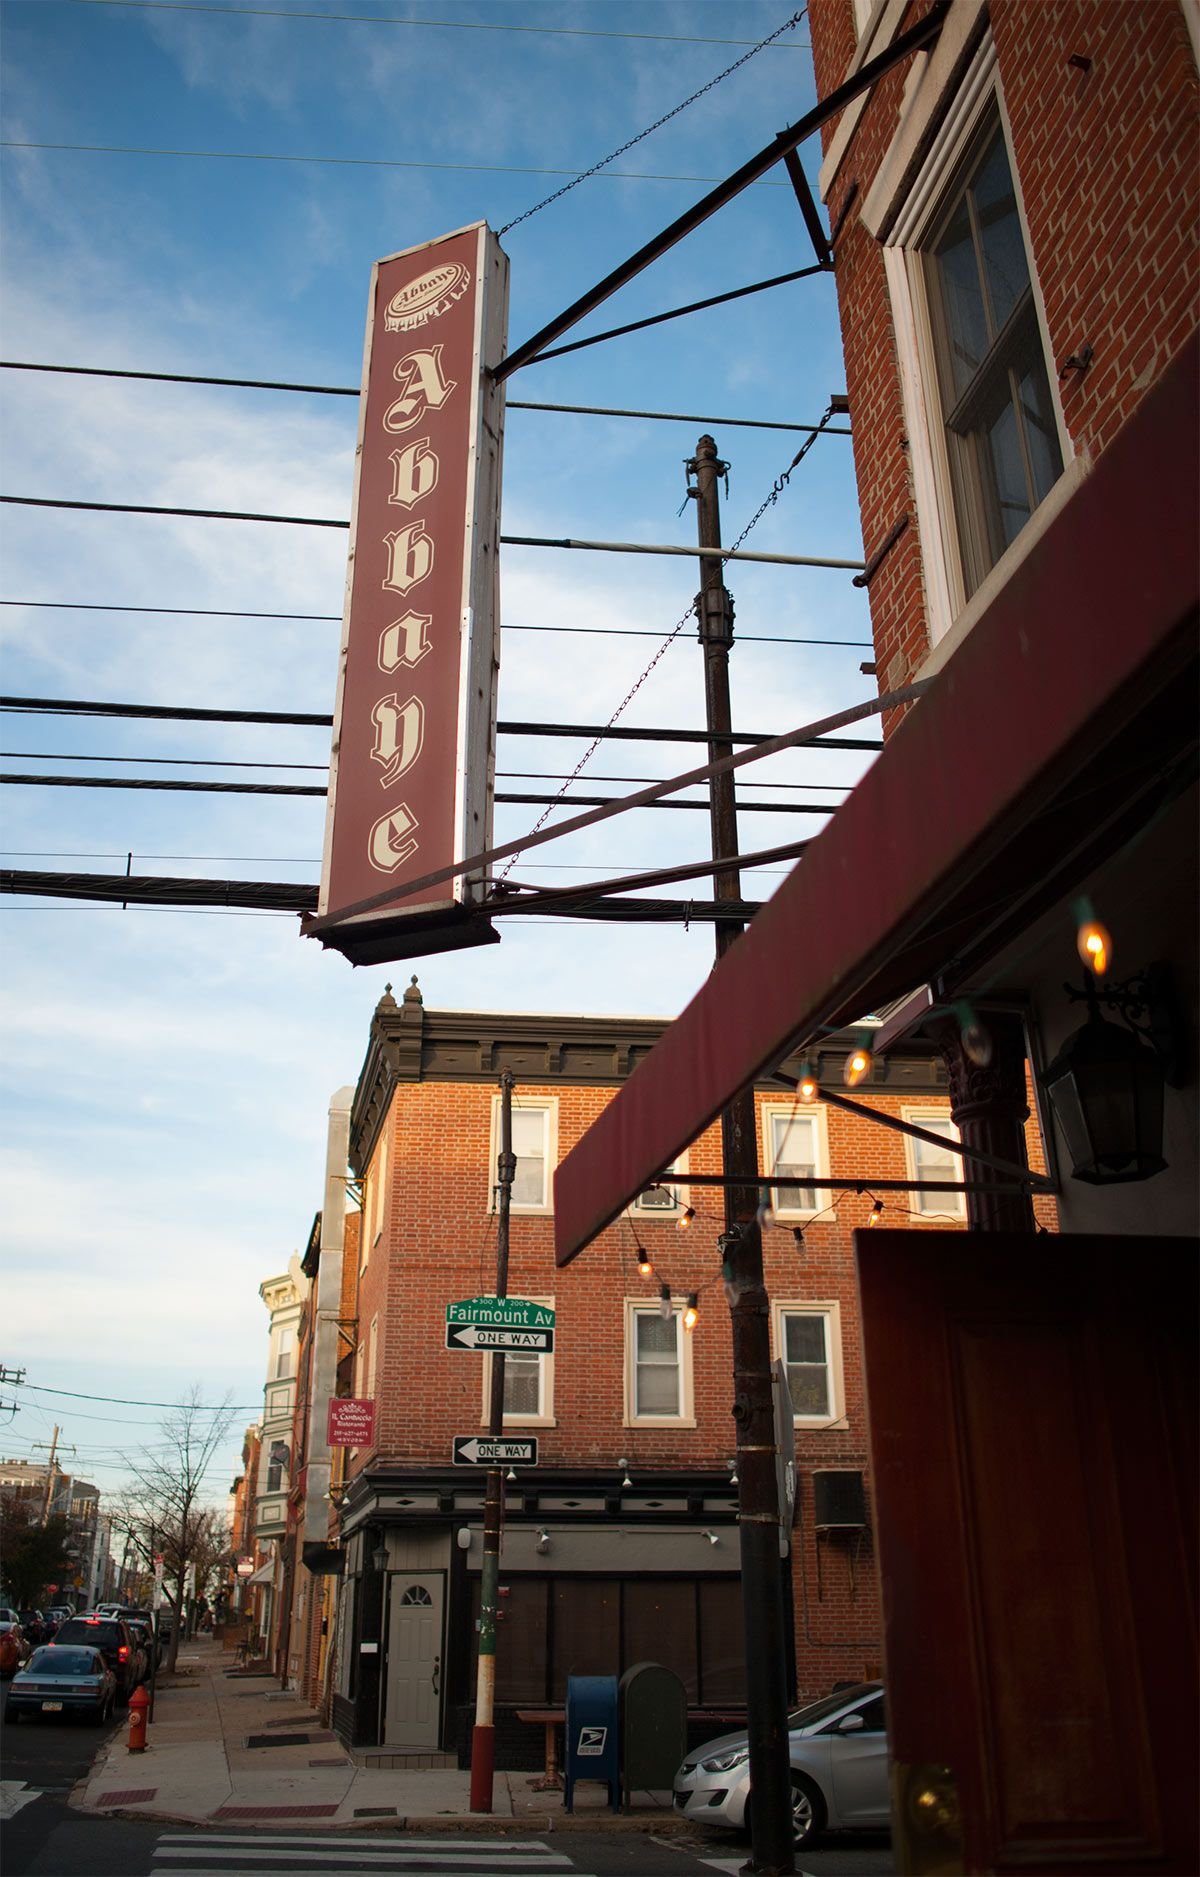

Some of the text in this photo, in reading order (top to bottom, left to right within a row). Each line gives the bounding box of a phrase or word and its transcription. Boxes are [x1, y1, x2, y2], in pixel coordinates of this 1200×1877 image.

[396, 268, 455, 308] Abbaye
[367, 344, 458, 874] Abbaye
[497, 1299, 506, 1307] W
[449, 1305, 553, 1325] Fairmount Av
[477, 1332, 540, 1345] ONE WAY
[478, 1445, 528, 1457] ONE WAY
